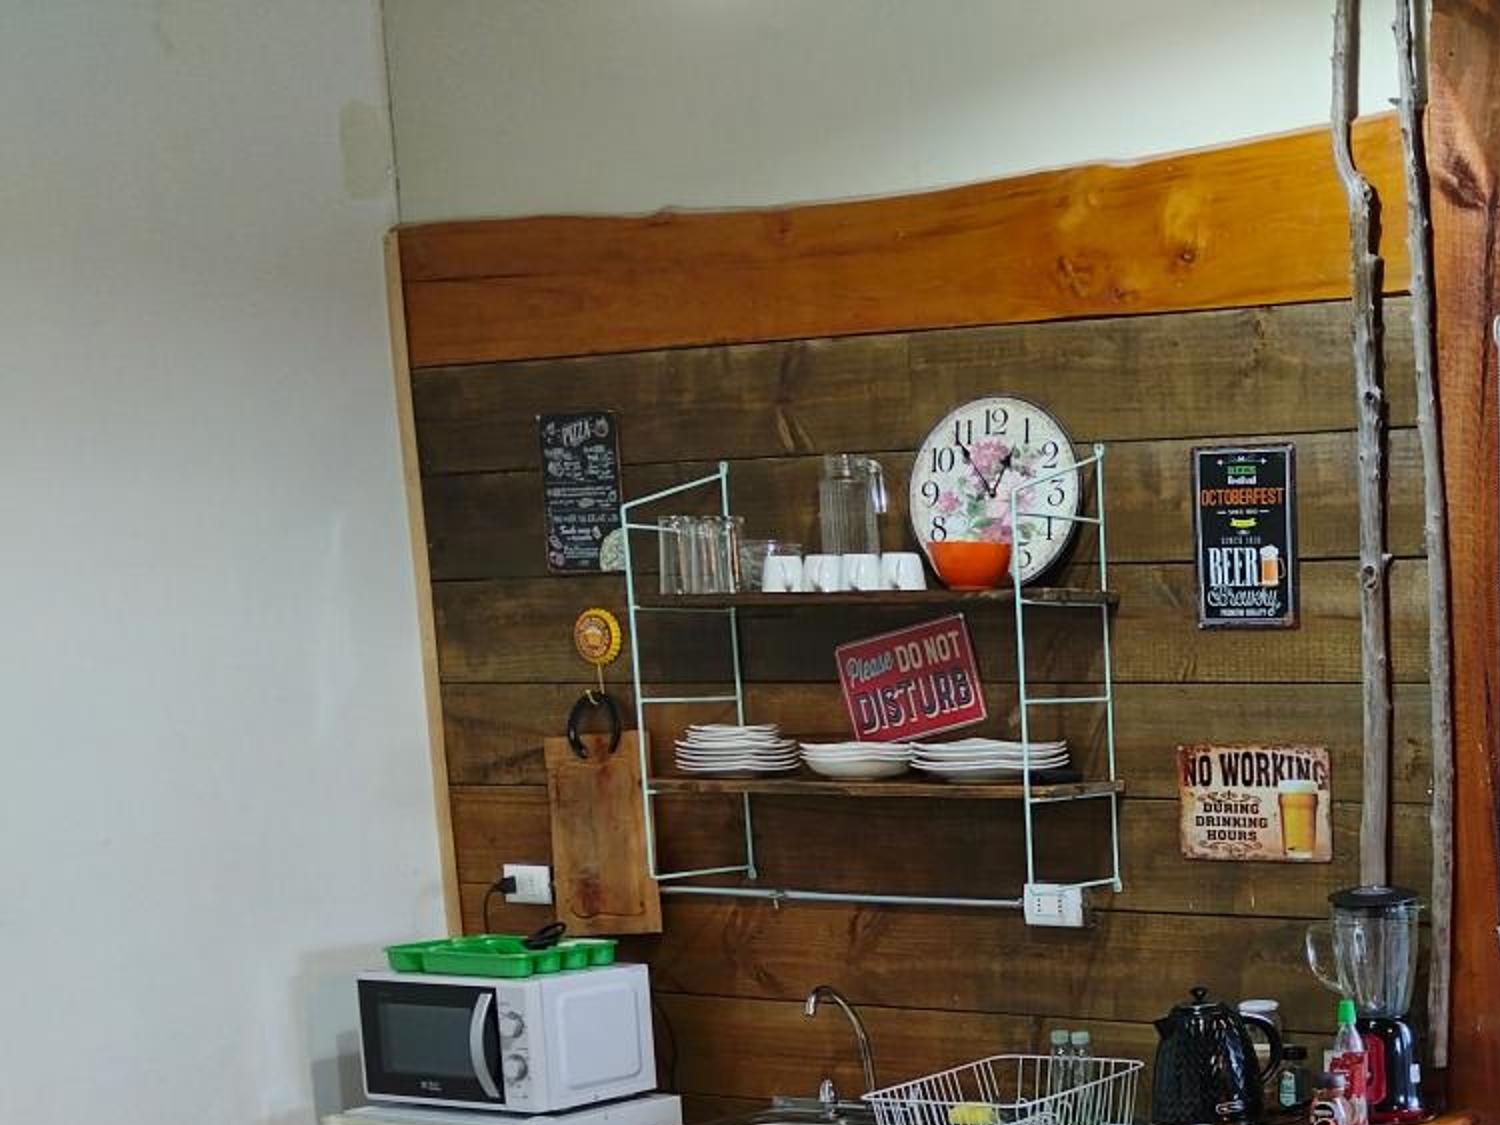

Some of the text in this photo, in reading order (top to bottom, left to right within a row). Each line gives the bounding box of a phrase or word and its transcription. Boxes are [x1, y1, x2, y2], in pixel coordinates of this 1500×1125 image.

[955, 419, 972, 445] 11
[985, 408, 1009, 435] 12
[1024, 417, 1030, 444] 1
[931, 447, 955, 473] 10
[1041, 441, 1060, 469] 2
[921, 480, 940, 508] 9
[1047, 479, 1065, 507] 3
[1201, 487, 1285, 506] OCTOBERFEST
[931, 515, 947, 541] 8
[1207, 547, 1260, 587] BEER
[847, 631, 961, 689] Please DO NOT
[853, 666, 975, 735] DISTURB
[1184, 751, 1328, 790] NO WORKING
[1203, 801, 1260, 815] DURING
[1195, 815, 1269, 829] DRINKING
[1206, 829, 1258, 842] HOURS
